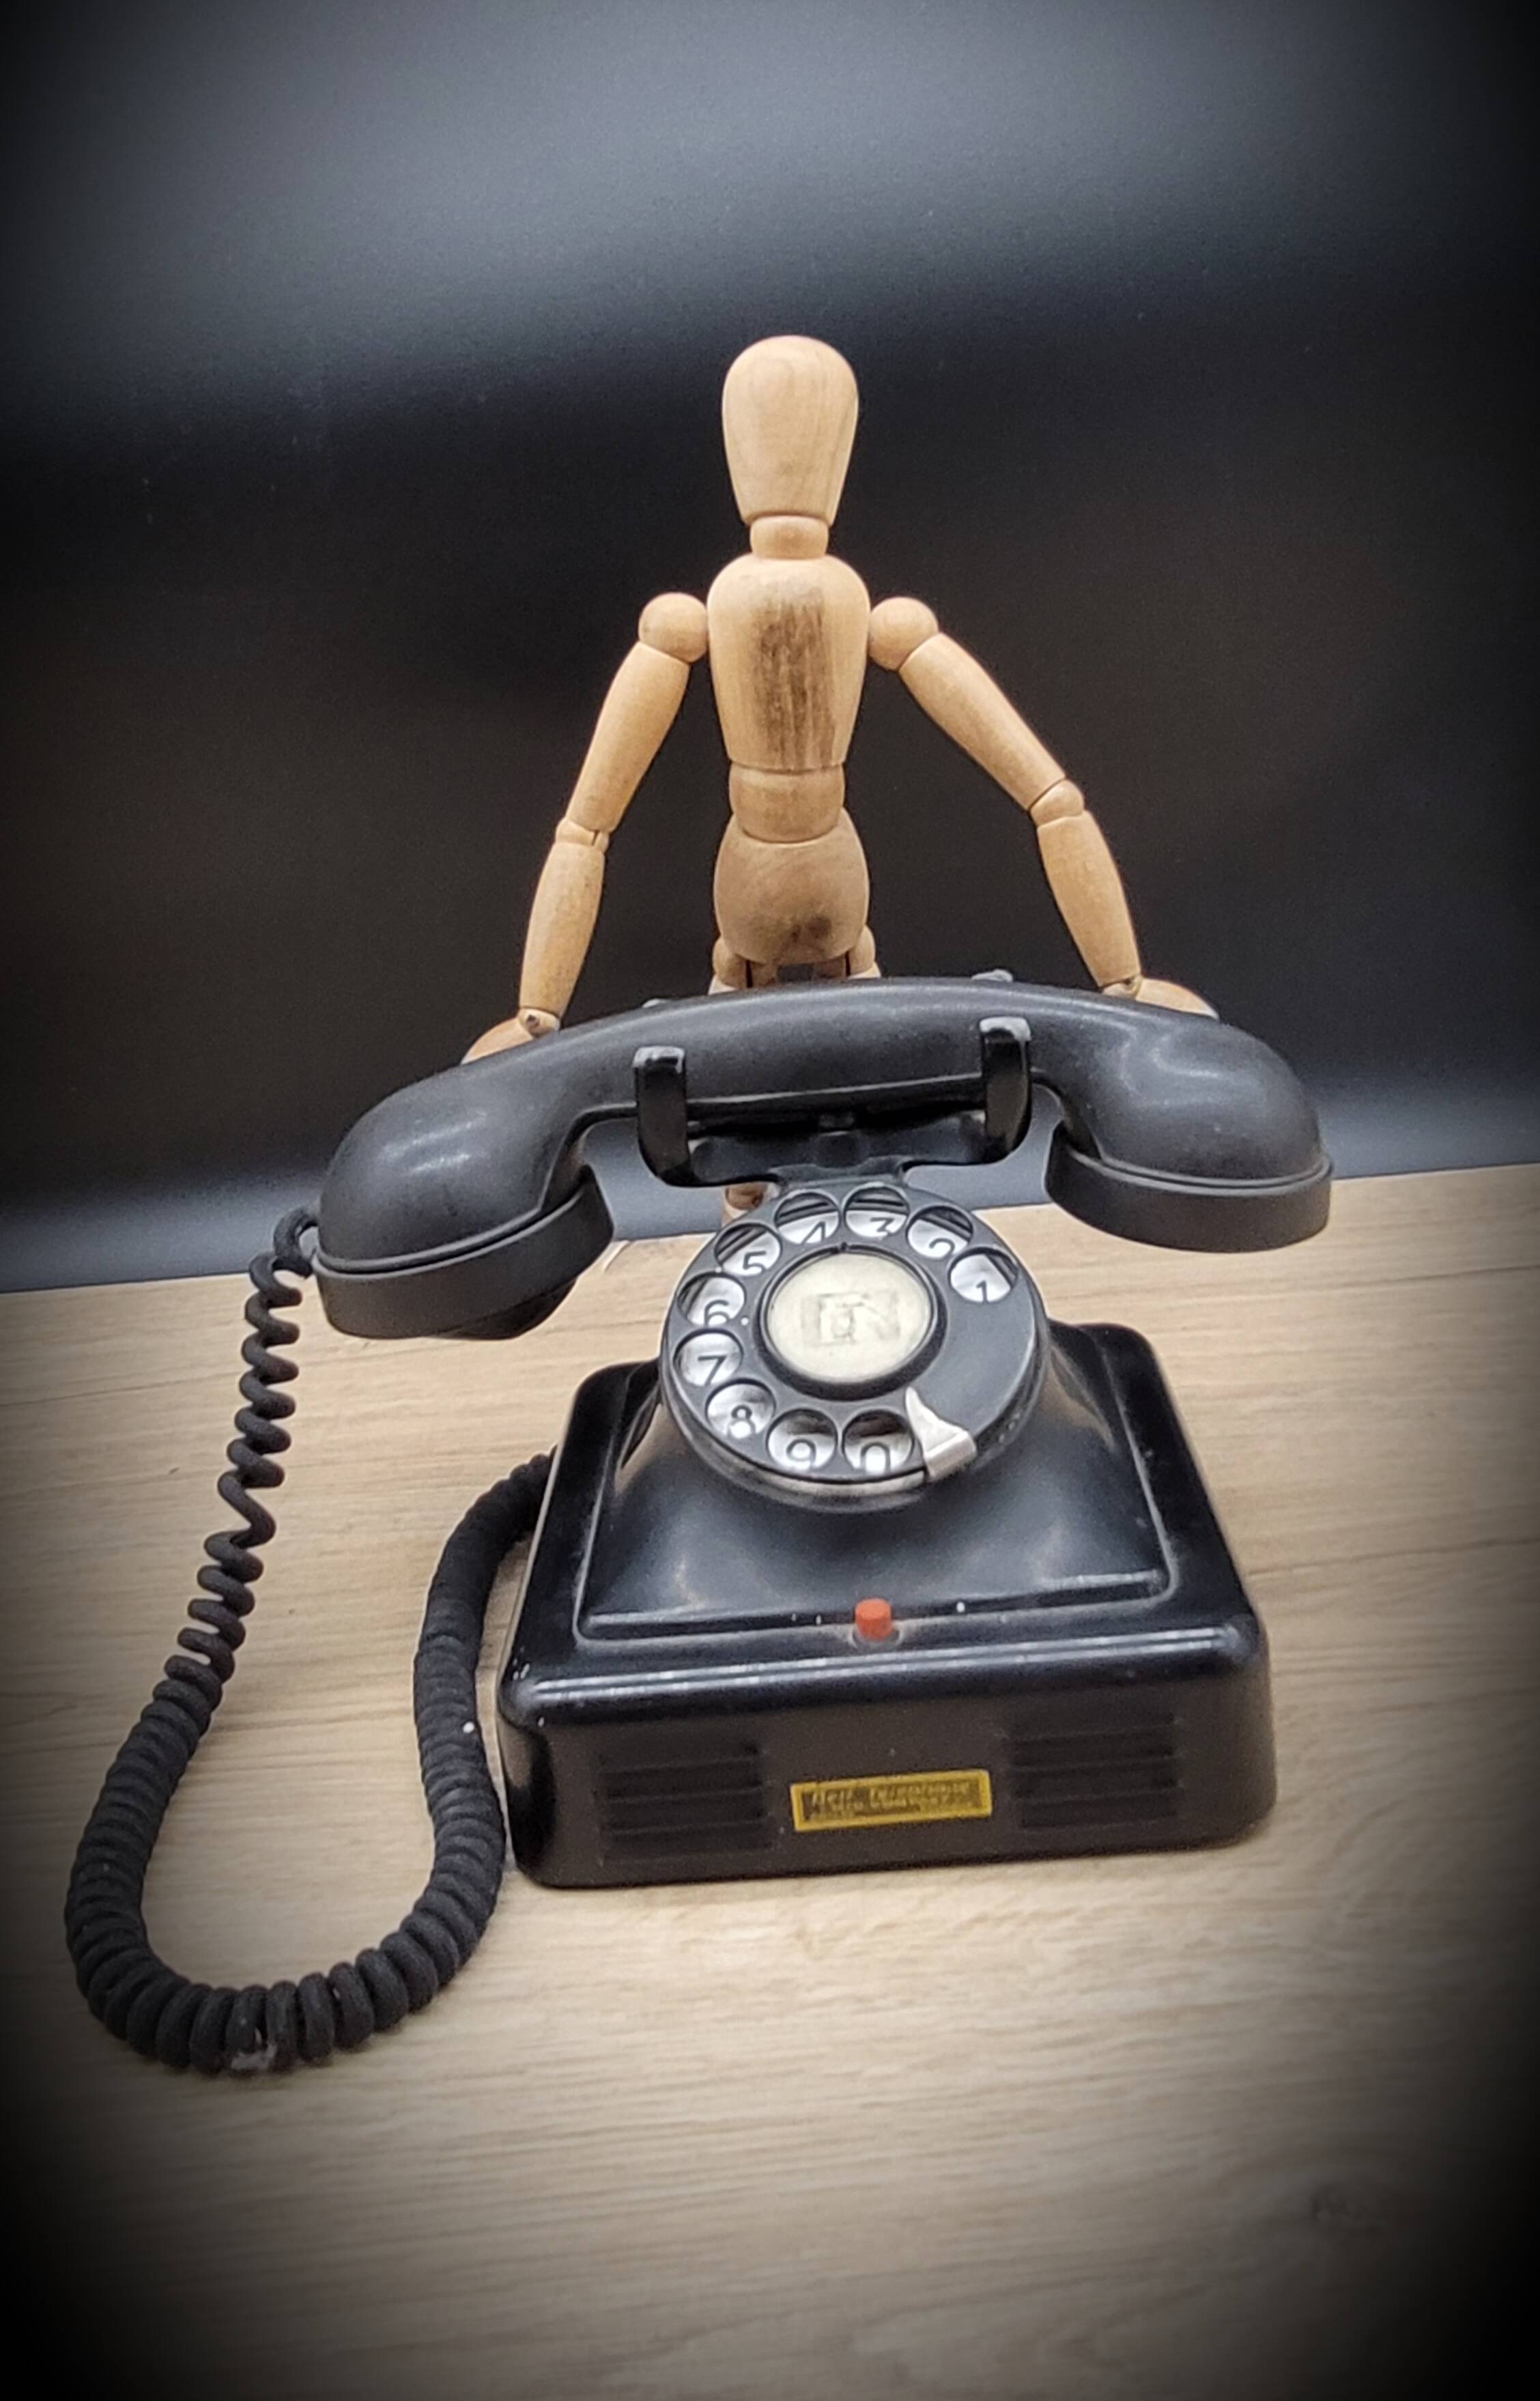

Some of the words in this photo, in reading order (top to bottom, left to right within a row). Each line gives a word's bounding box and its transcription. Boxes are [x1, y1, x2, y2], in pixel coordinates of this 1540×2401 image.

[800, 1221, 827, 1245] 4
[742, 1251, 767, 1273] 5
[975, 1279, 988, 1302] 1
[704, 1299, 730, 1326] 6
[697, 1355, 727, 1387] 7
[726, 1404, 756, 1436] 8
[786, 1438, 817, 1471] 9
